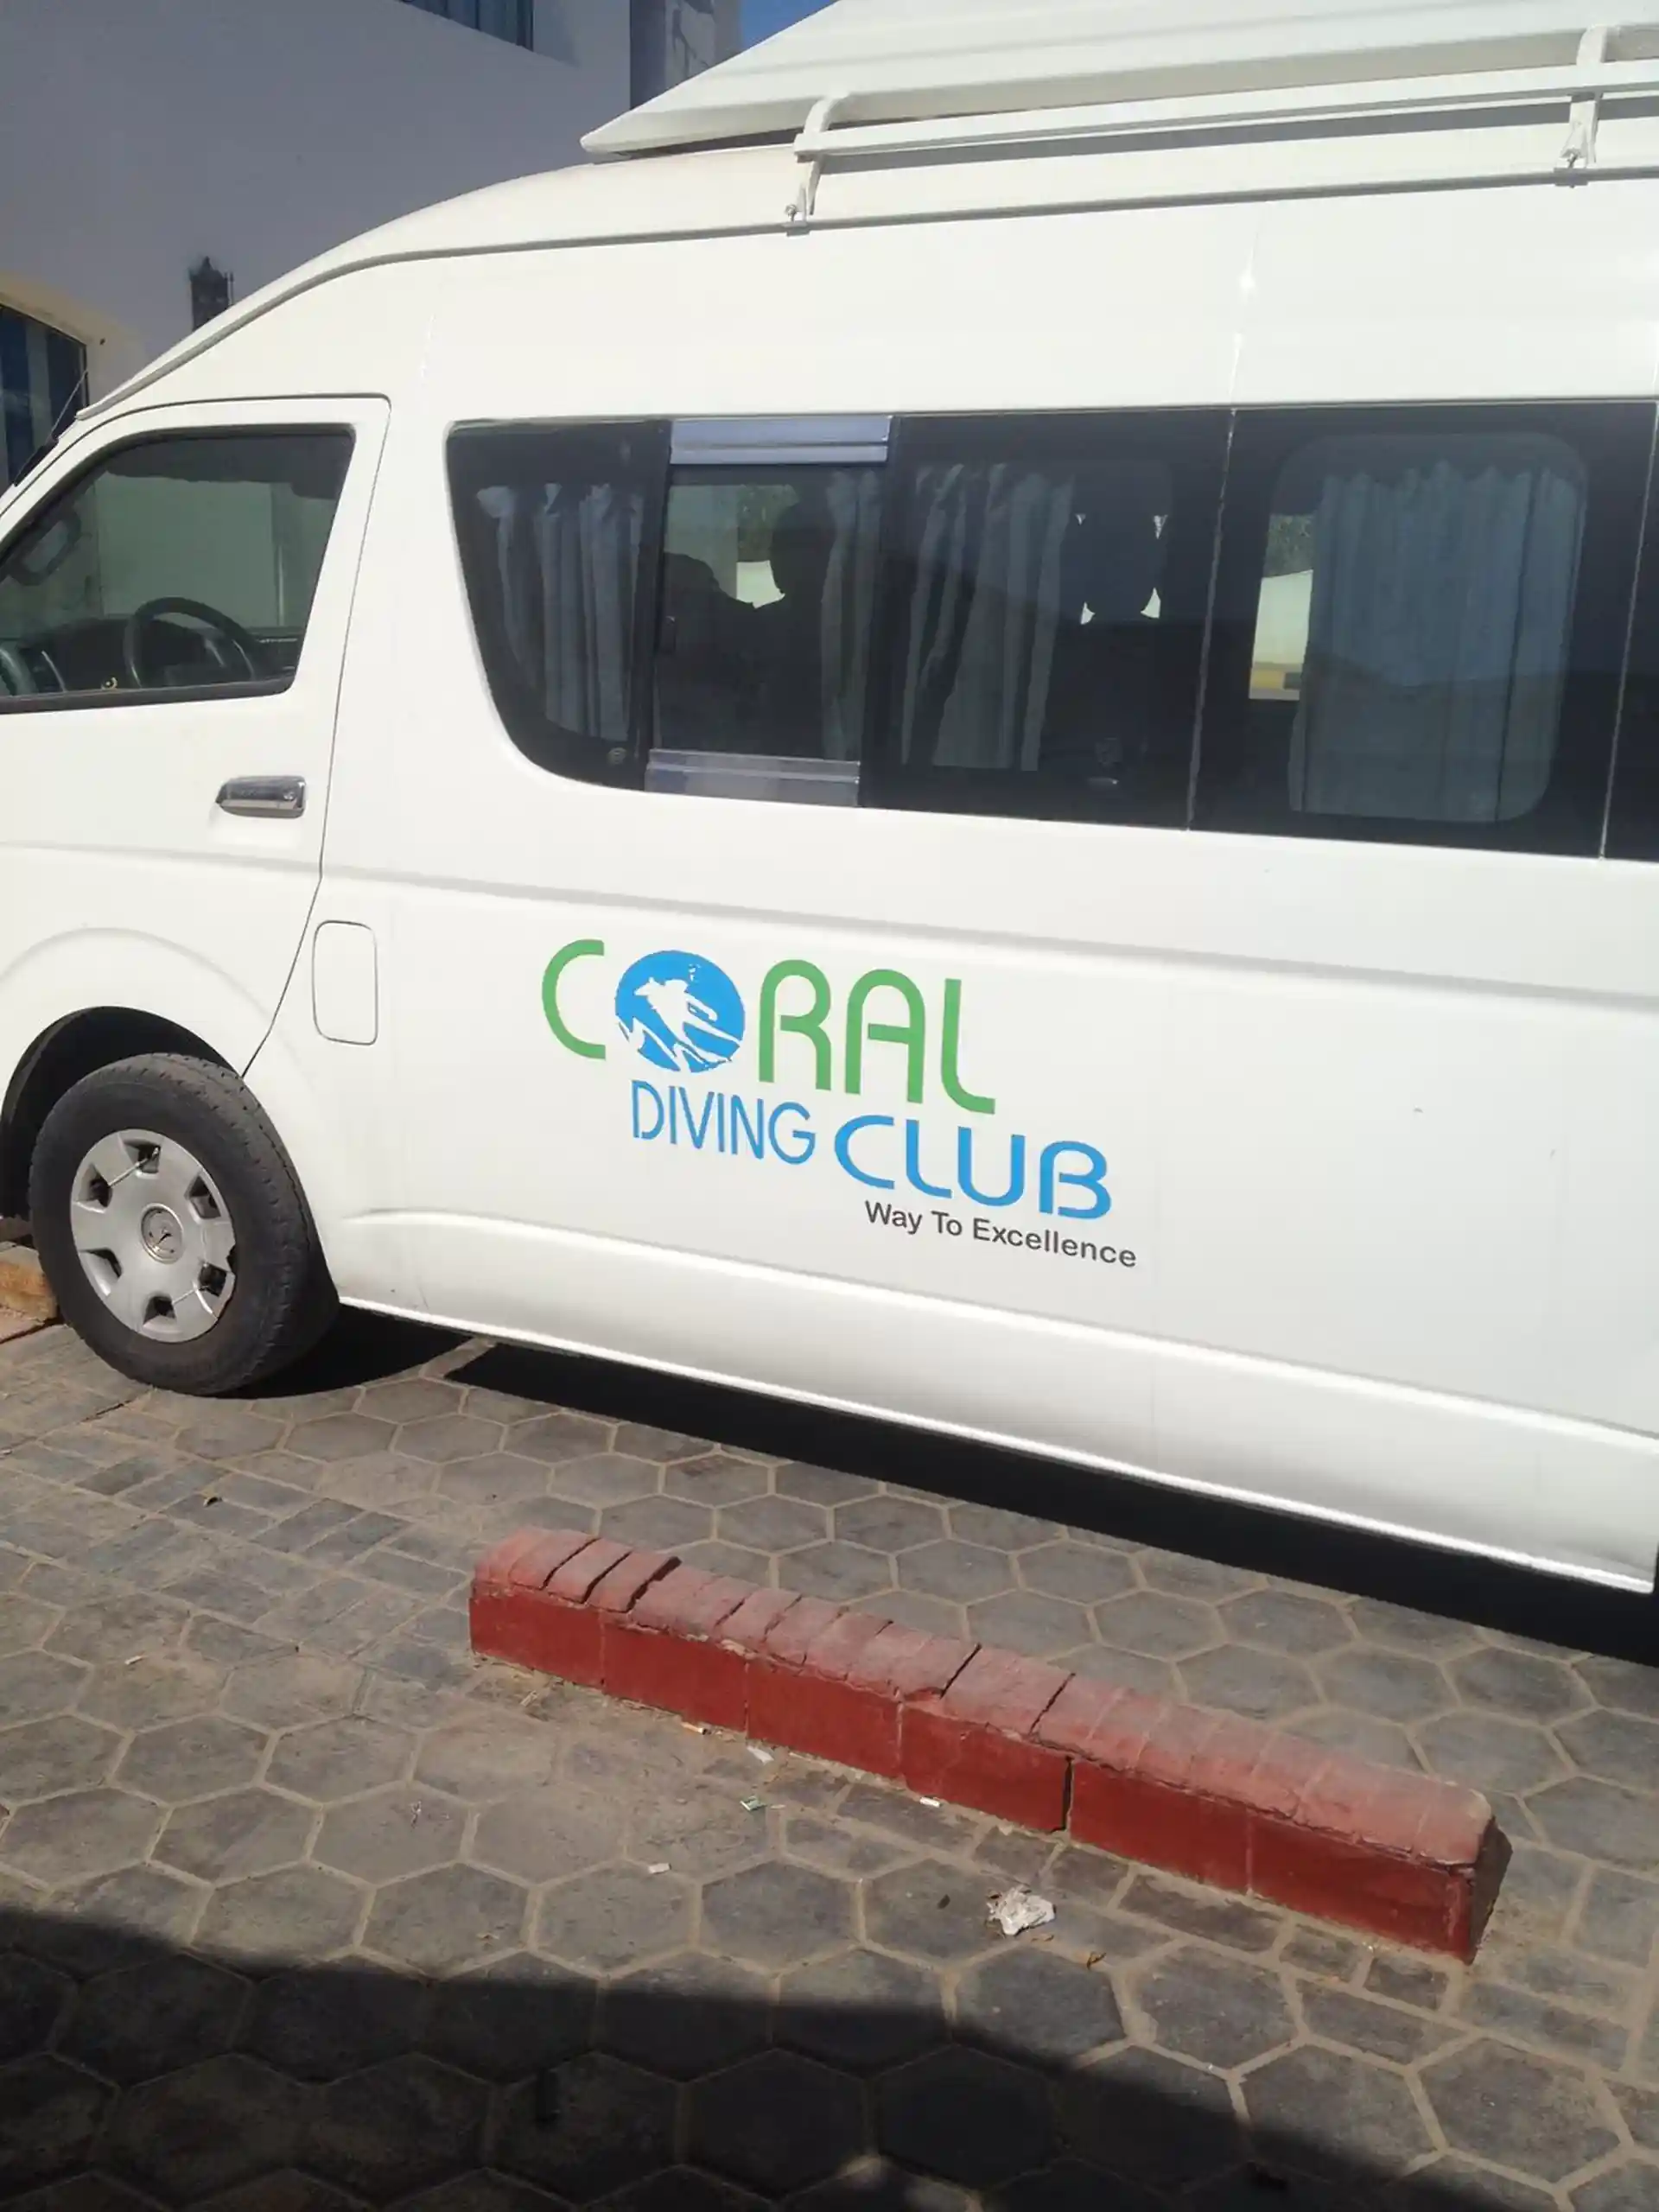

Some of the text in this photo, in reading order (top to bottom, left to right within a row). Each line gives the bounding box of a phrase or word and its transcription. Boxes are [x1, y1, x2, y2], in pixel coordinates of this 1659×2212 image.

[541, 938, 996, 1115] CORAL
[630, 1079, 1113, 1222] DIVING CLUB
[864, 1199, 1138, 1268] Way To Excellence
